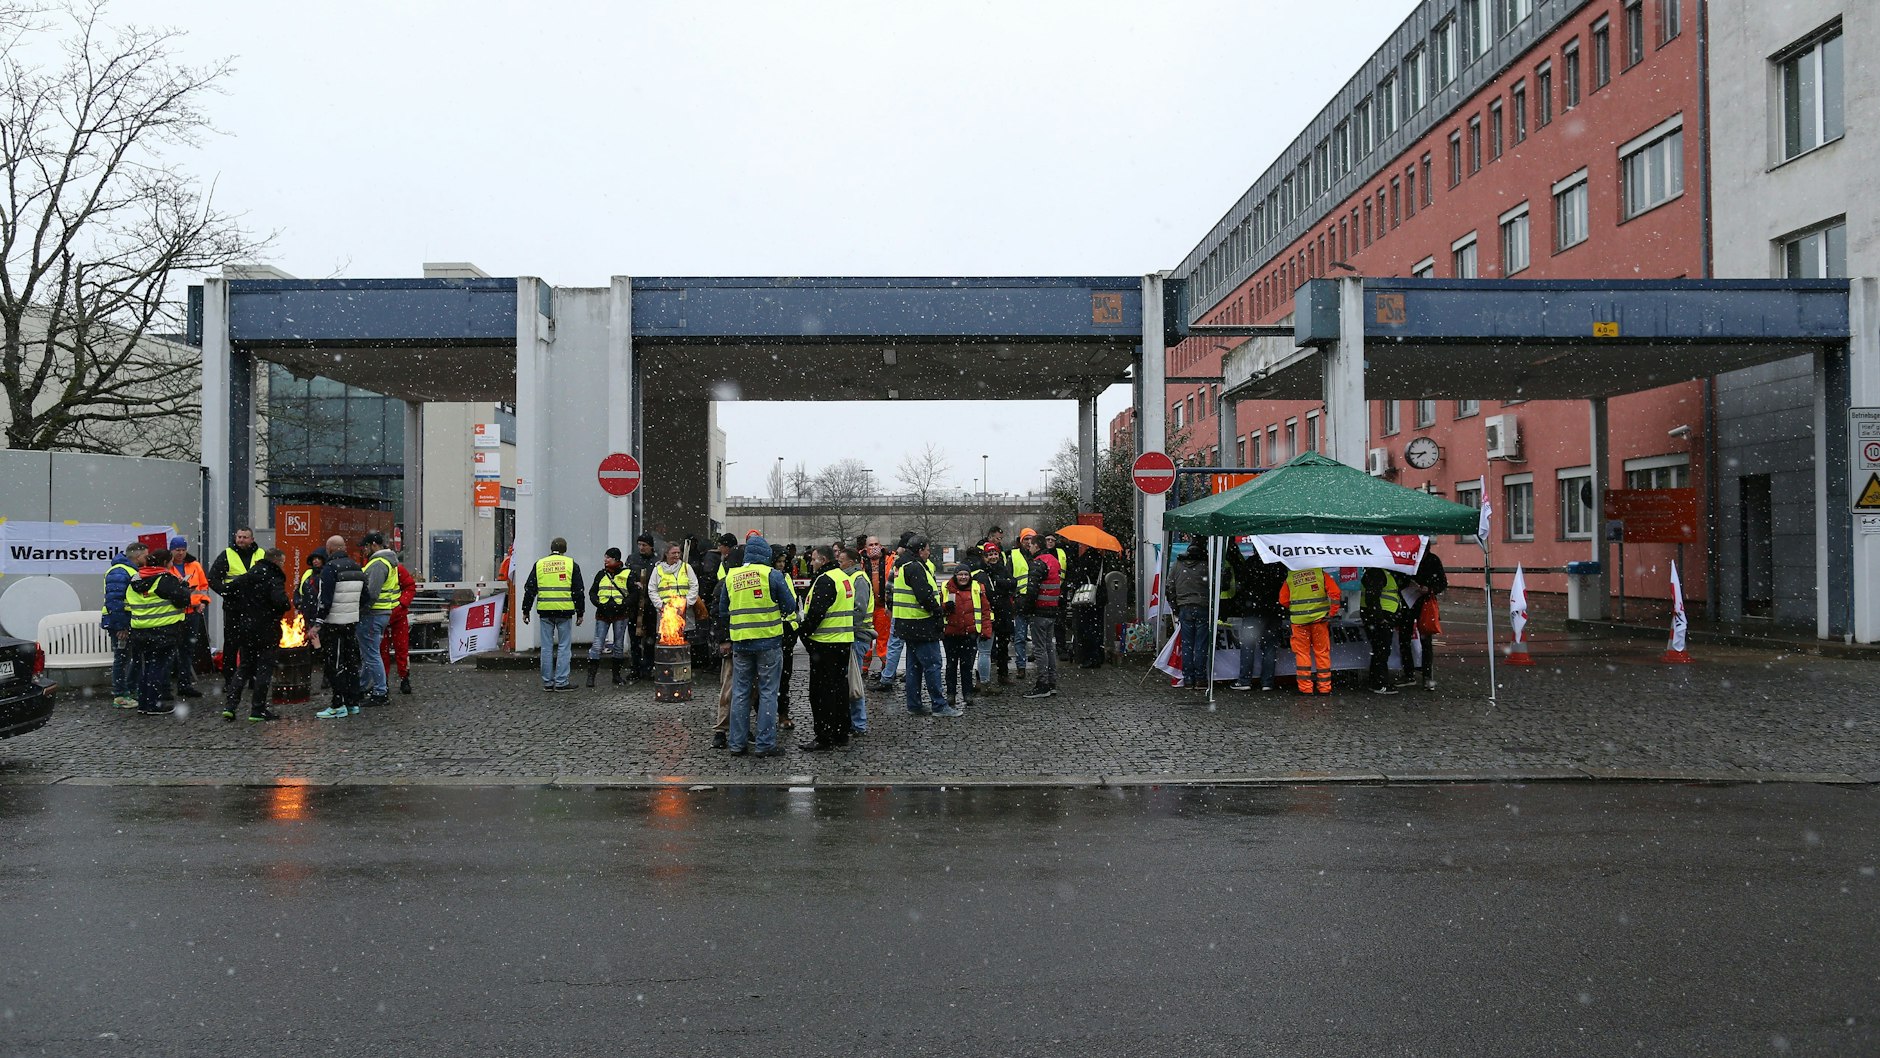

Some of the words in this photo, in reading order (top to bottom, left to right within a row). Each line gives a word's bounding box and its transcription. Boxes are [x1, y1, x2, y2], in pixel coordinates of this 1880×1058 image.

[1094, 297, 1119, 320] BSR
[1378, 297, 1403, 320] BSR
[1868, 447, 1879, 457] 10
[288, 516, 307, 531] BSR
[733, 571, 761, 583] ZUSAMMEN
[0, 662, 13, 674] 21
